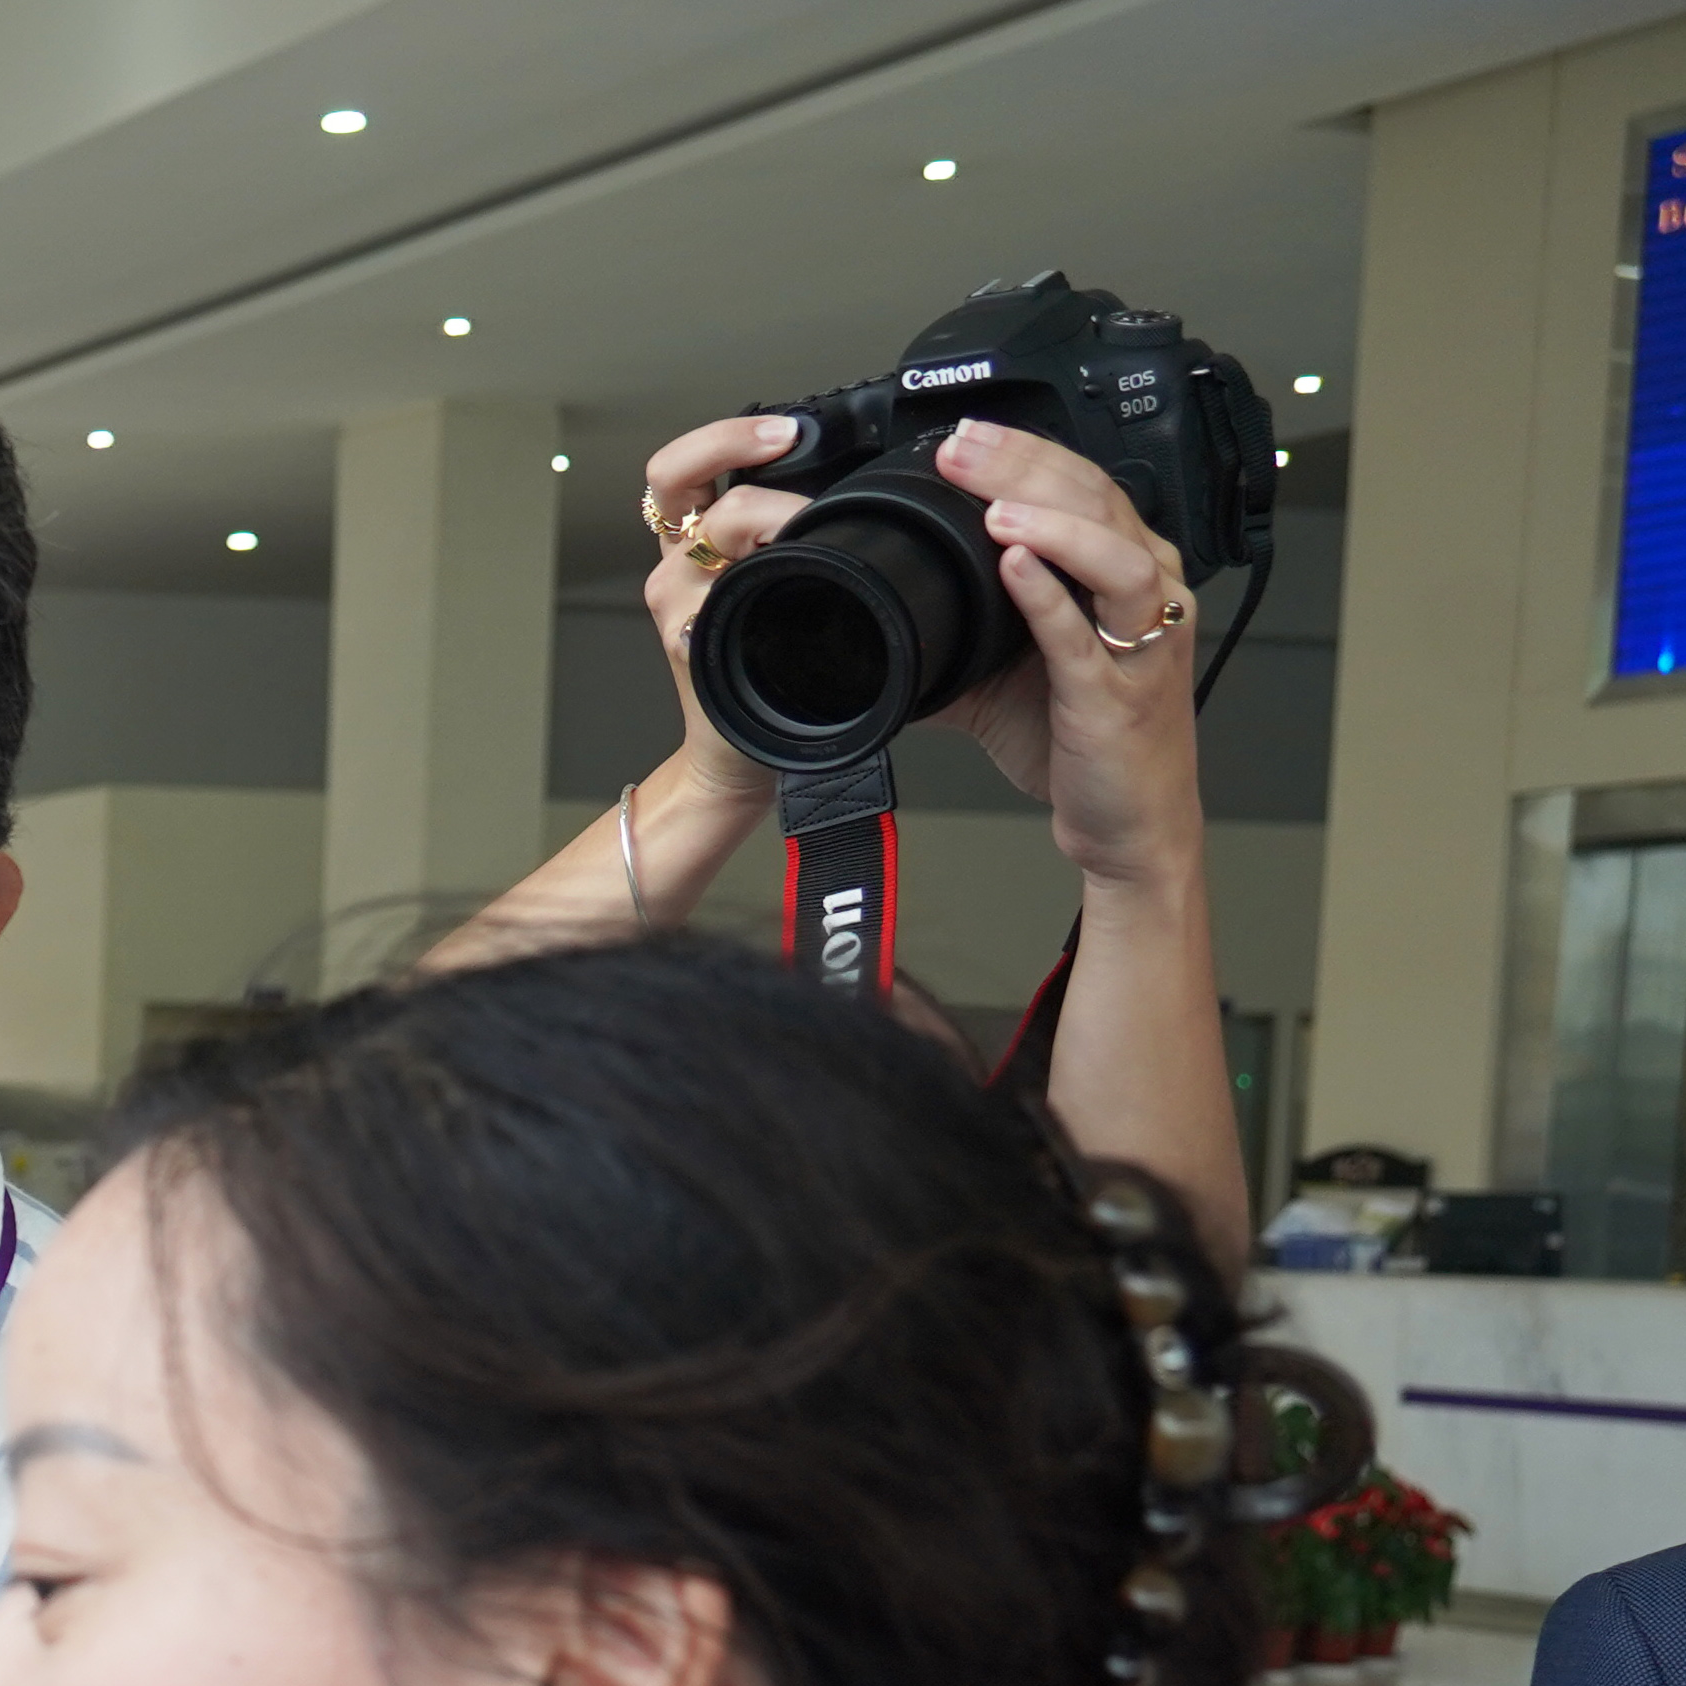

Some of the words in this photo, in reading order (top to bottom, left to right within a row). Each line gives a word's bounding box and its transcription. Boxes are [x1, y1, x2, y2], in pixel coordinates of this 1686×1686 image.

[901, 360, 992, 391] Canon
[1117, 369, 1157, 392] EOS
[1119, 394, 1158, 418] 90D
